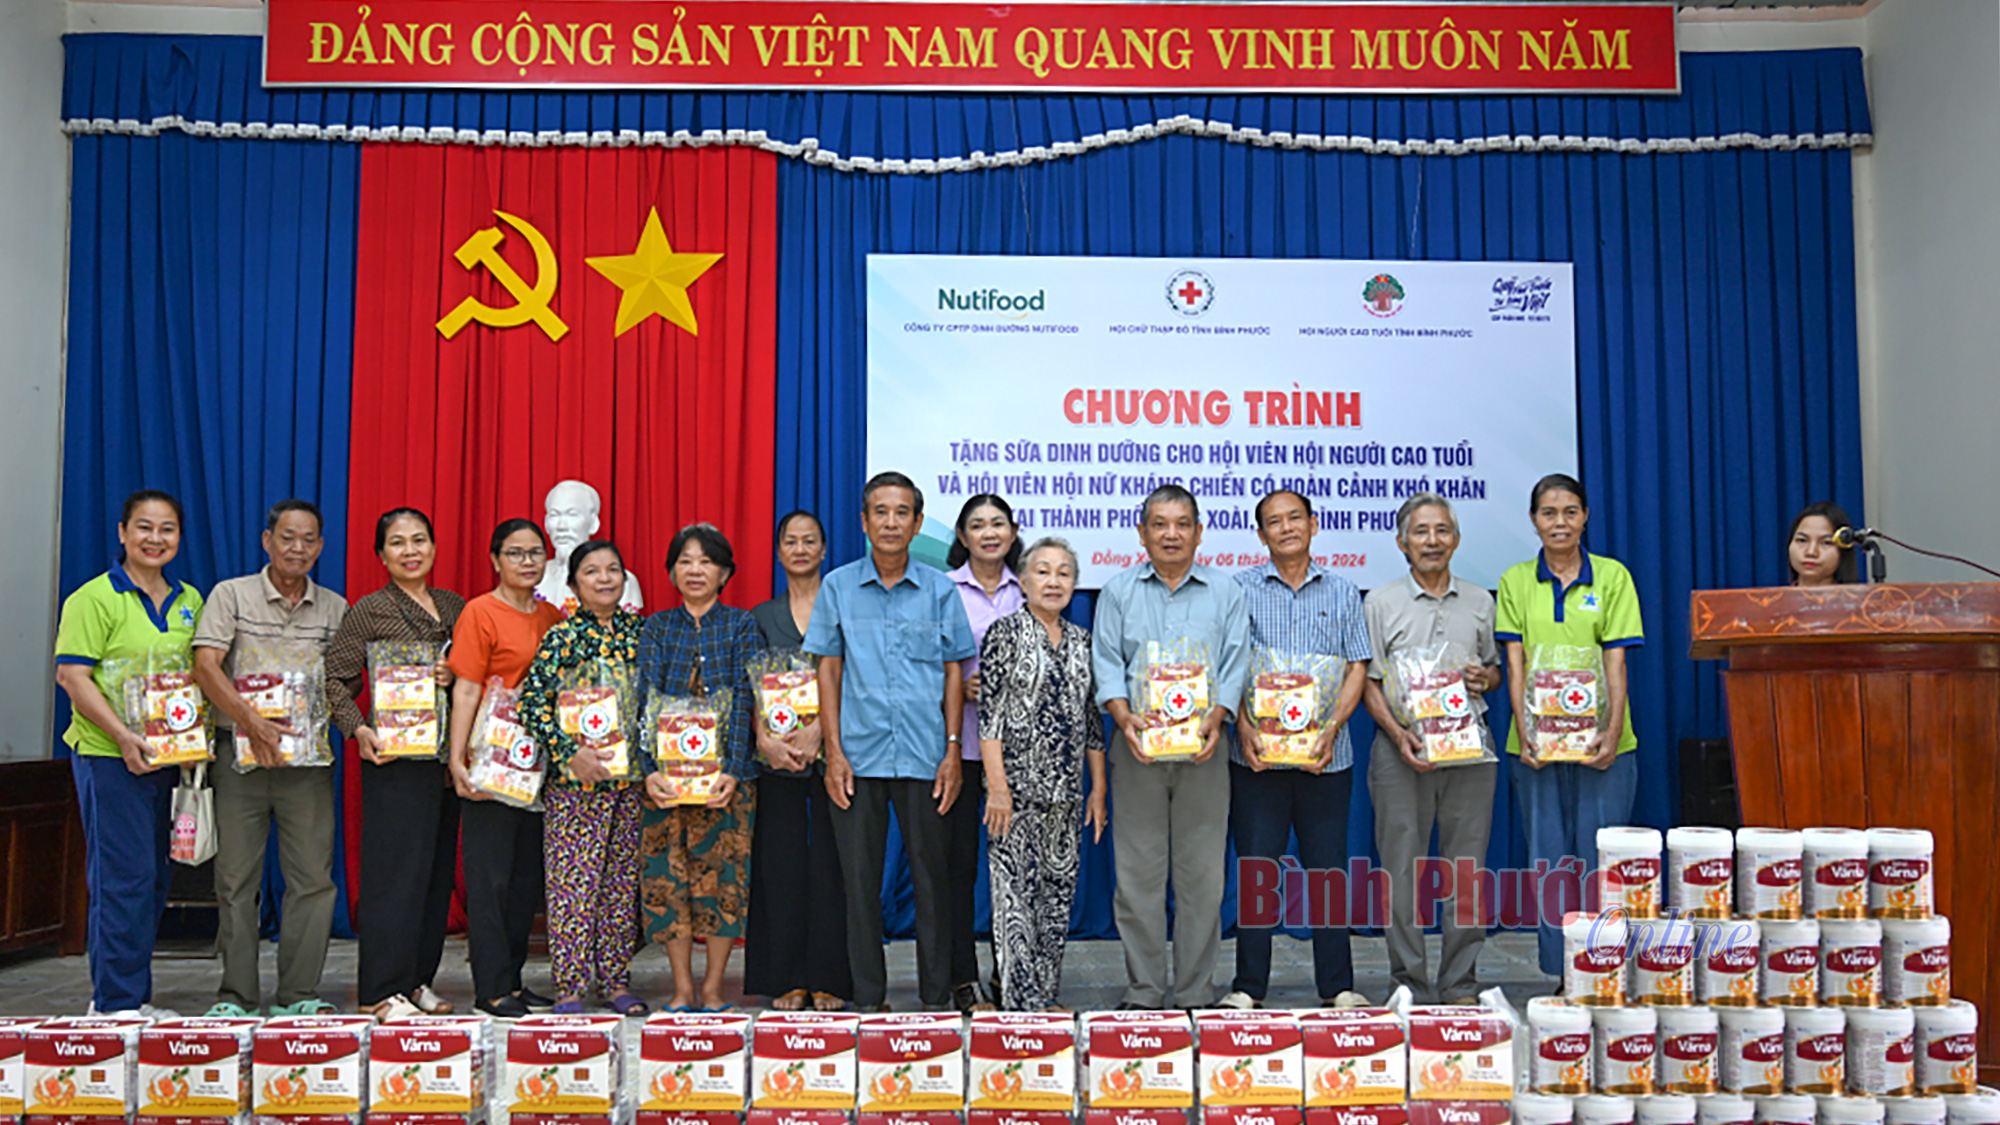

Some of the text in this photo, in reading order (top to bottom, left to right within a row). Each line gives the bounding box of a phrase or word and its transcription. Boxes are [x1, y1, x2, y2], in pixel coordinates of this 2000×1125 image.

[308, 6, 1630, 78] ĐẢNG CỘNG SẢN VIỆT NAM QUANG VINH MUÔN NĂM
[938, 288, 1045, 311] Nutifood
[1064, 384, 1360, 426] CHƯƠNG TRÌNH
[949, 438, 1473, 469] TẶNG SỮA DINH DƯỠNG CHO HỘI VIÊN HỘI NGƯỜI CAO TUỔI
[938, 471, 961, 494] VÀ
[1003, 471, 1046, 494] VIÊN
[1052, 472, 1082, 499] HỘI
[1088, 472, 1116, 495] NỮ
[1189, 470, 1245, 497] CHIẾN
[1250, 472, 1275, 496] CÓ
[1336, 470, 1388, 498] CẢNH
[1434, 475, 1486, 500] KHĂN
[1013, 508, 1034, 533] ẠI
[1040, 504, 1100, 528] THÀNH
[1206, 505, 1254, 530] XOÀI,
[1358, 508, 1398, 530] PHƯ
[1091, 549, 1132, 568] Đồng
[1216, 553, 1234, 566] 06
[1331, 553, 1366, 567] 2024
